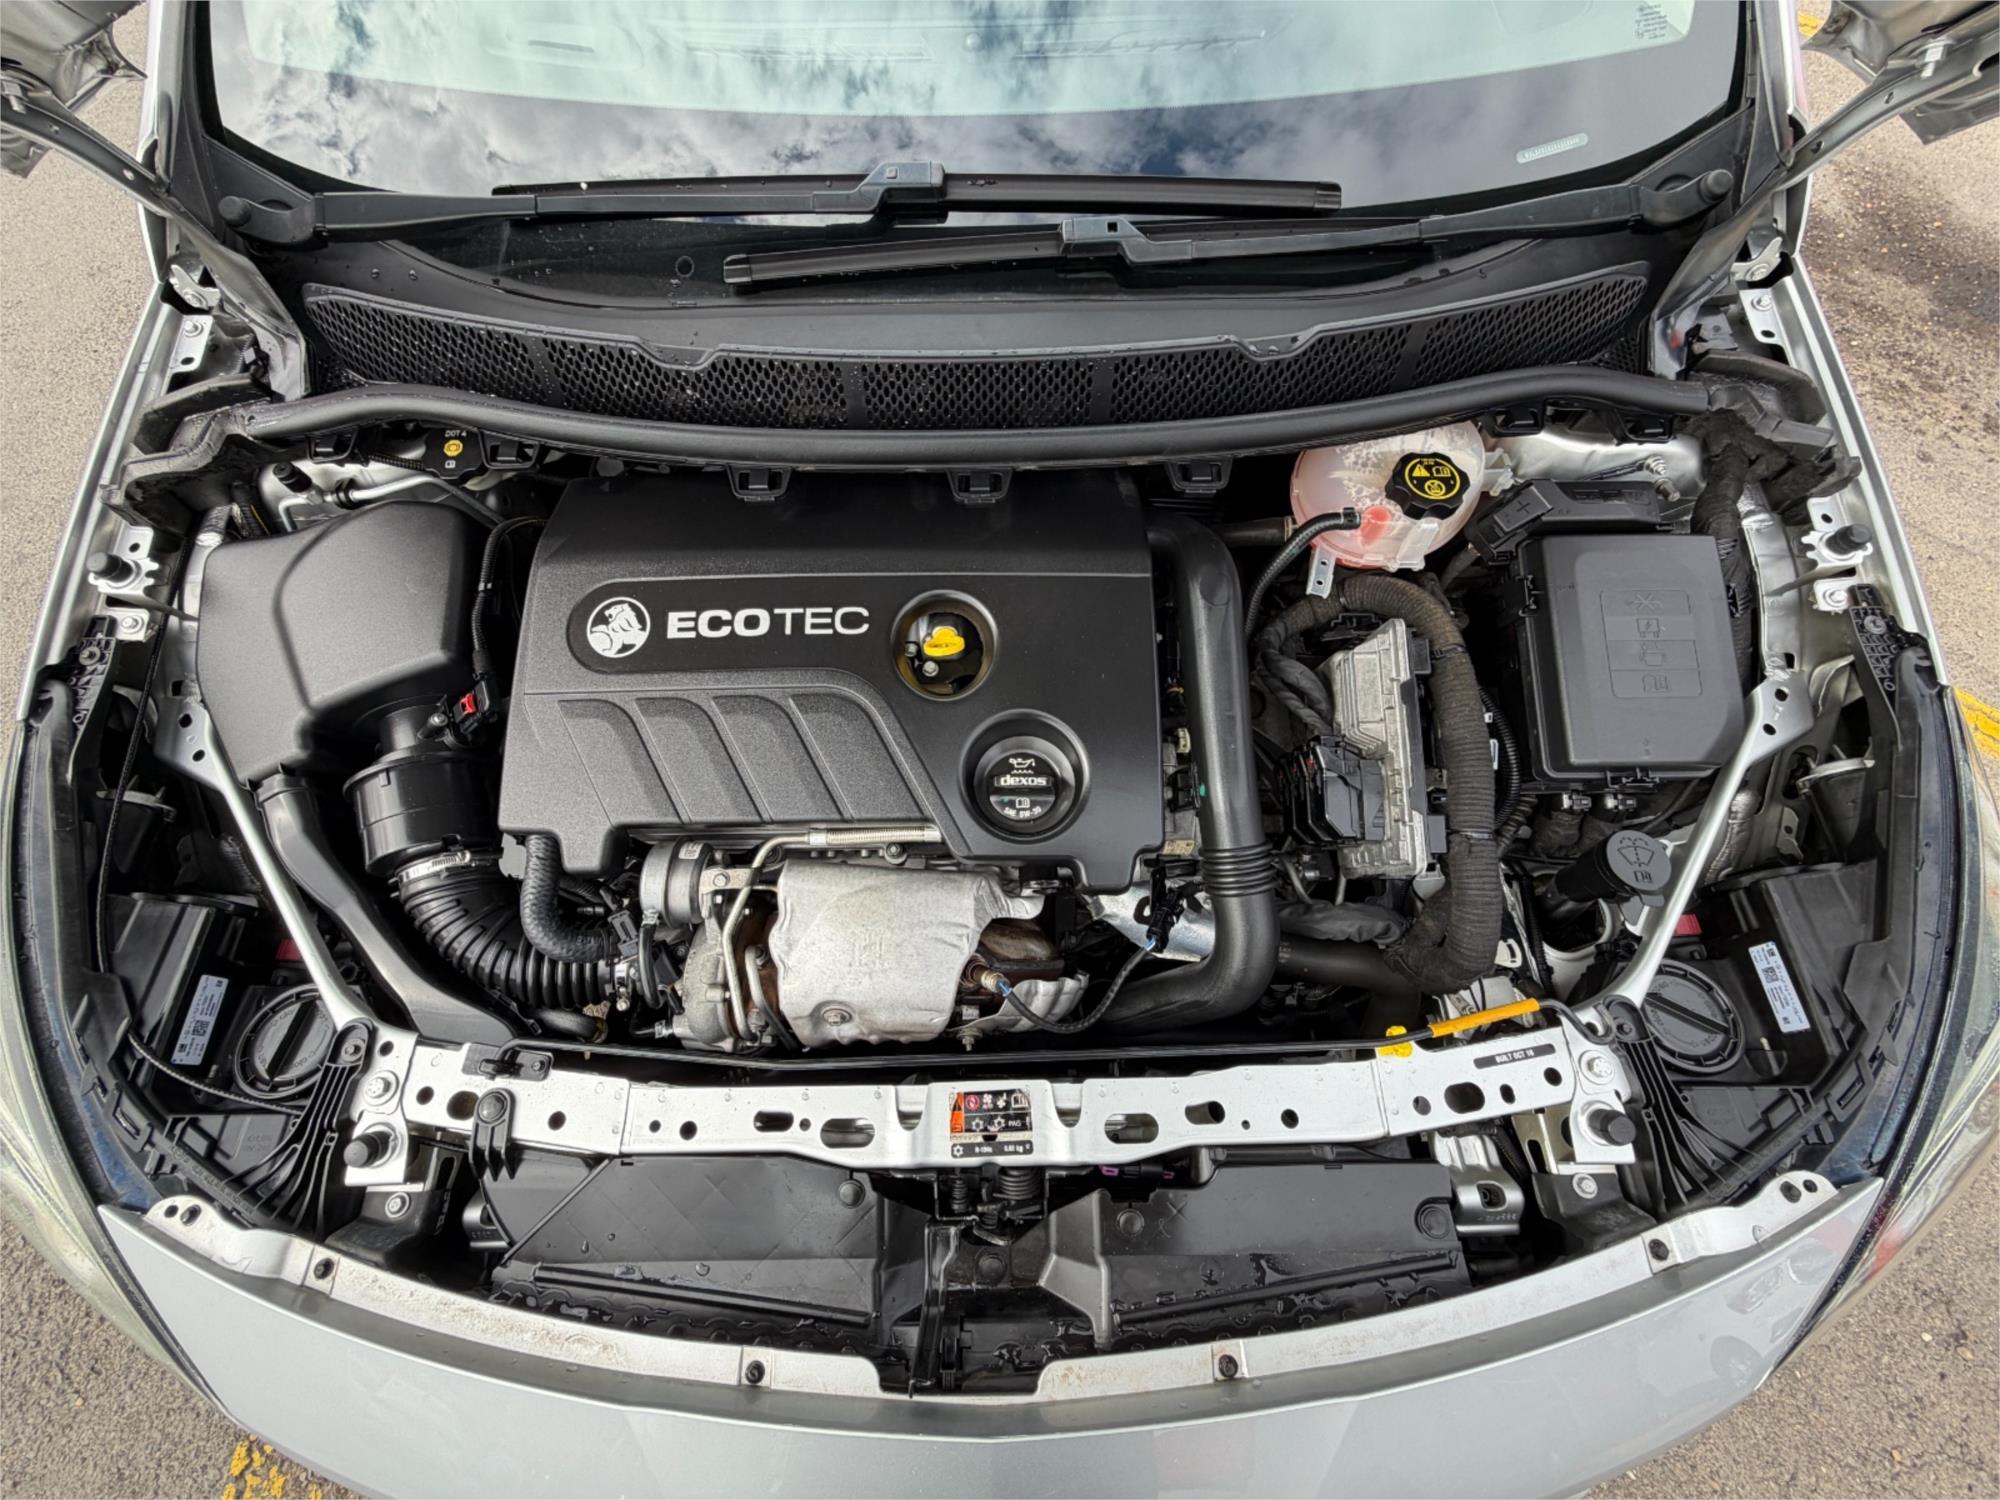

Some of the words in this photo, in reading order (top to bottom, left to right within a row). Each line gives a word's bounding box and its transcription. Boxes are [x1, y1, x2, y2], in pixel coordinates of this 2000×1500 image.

[445, 430, 460, 438] DOT
[667, 606, 870, 639] ECOTEC
[1000, 774, 1048, 786] dexos
[1495, 1053, 1512, 1063] BUILT
[1512, 1050, 1525, 1060] OCT
